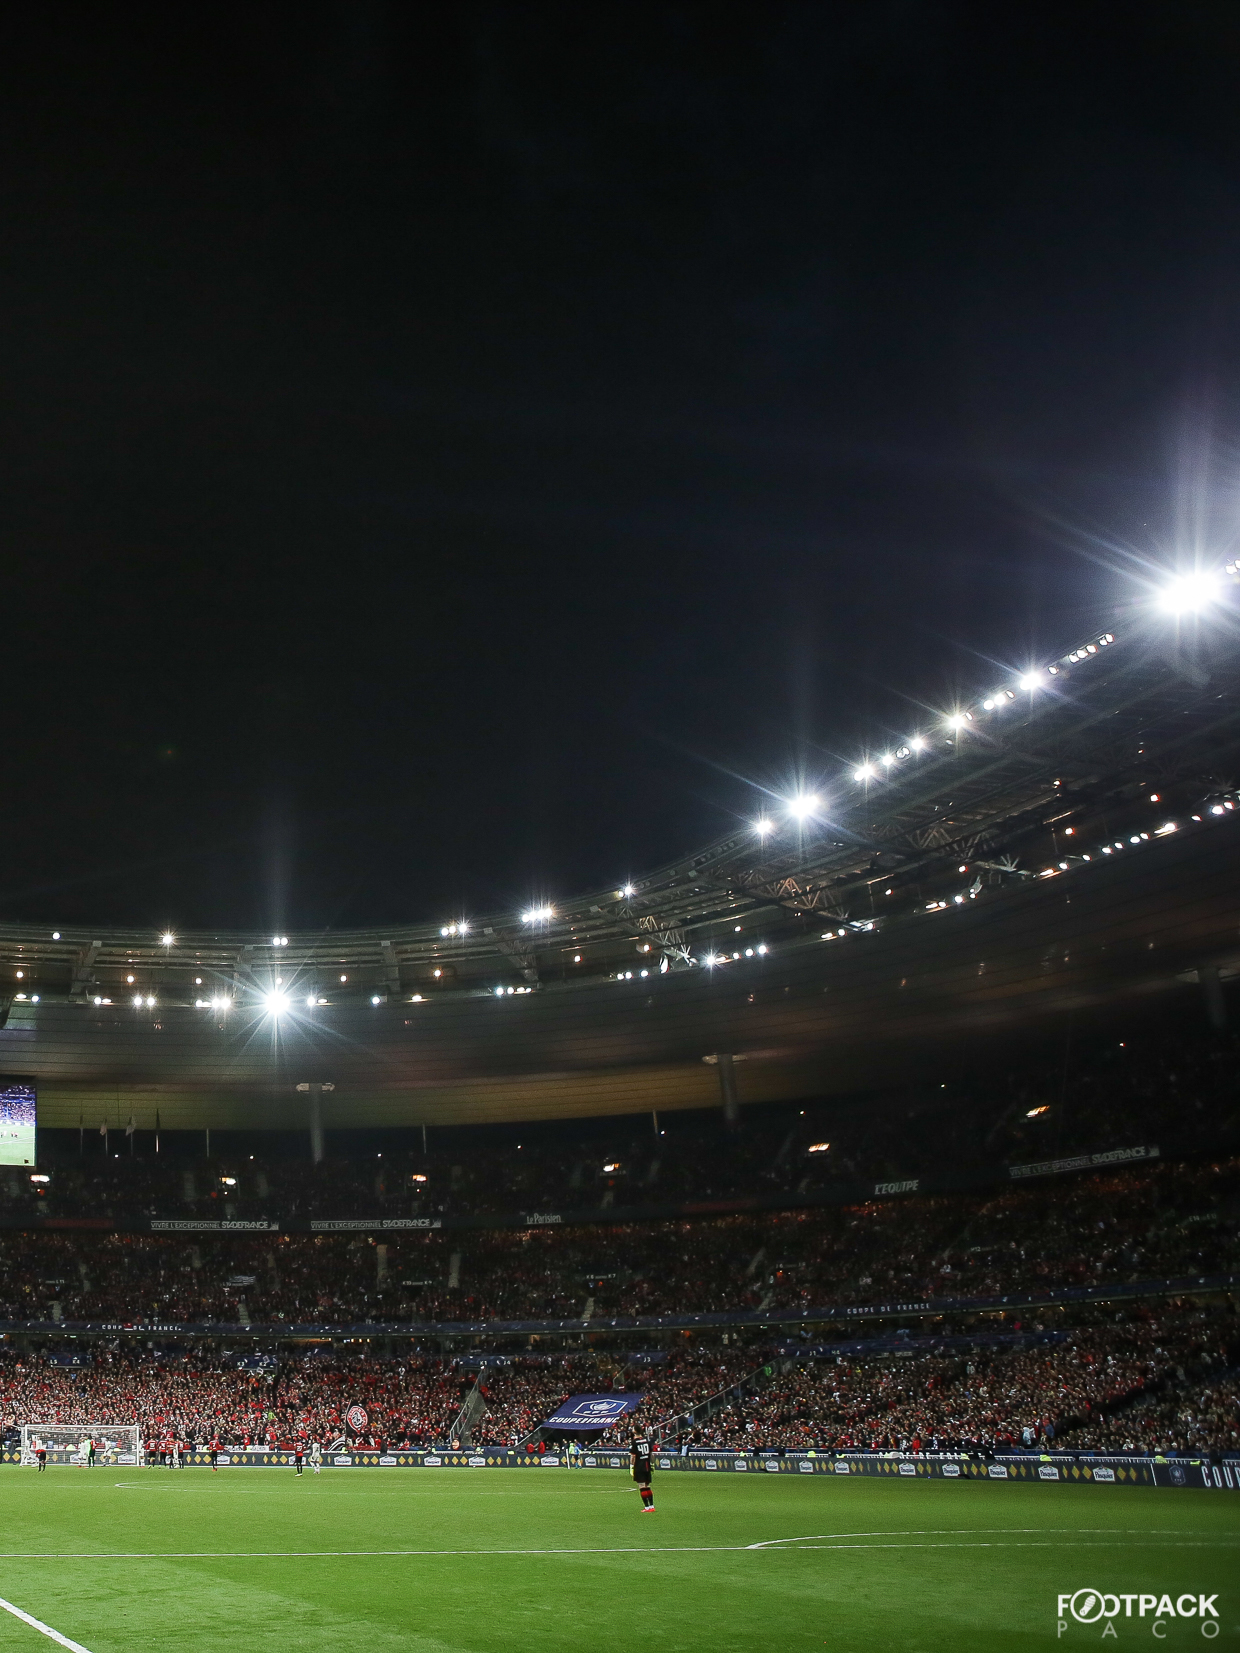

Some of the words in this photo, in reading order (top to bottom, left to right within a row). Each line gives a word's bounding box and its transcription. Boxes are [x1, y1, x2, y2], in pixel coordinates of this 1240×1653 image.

[874, 1180, 919, 1195] L'EQUIPE
[330, 1220, 382, 1228] L'EXCEPTIONNEL
[846, 1306, 874, 1315] COUPE
[897, 1303, 930, 1311] FRANCE
[637, 1443, 650, 1455] 40
[1040, 1469, 1058, 1478] Pasquier
[1095, 1471, 1114, 1479] Pasquier
